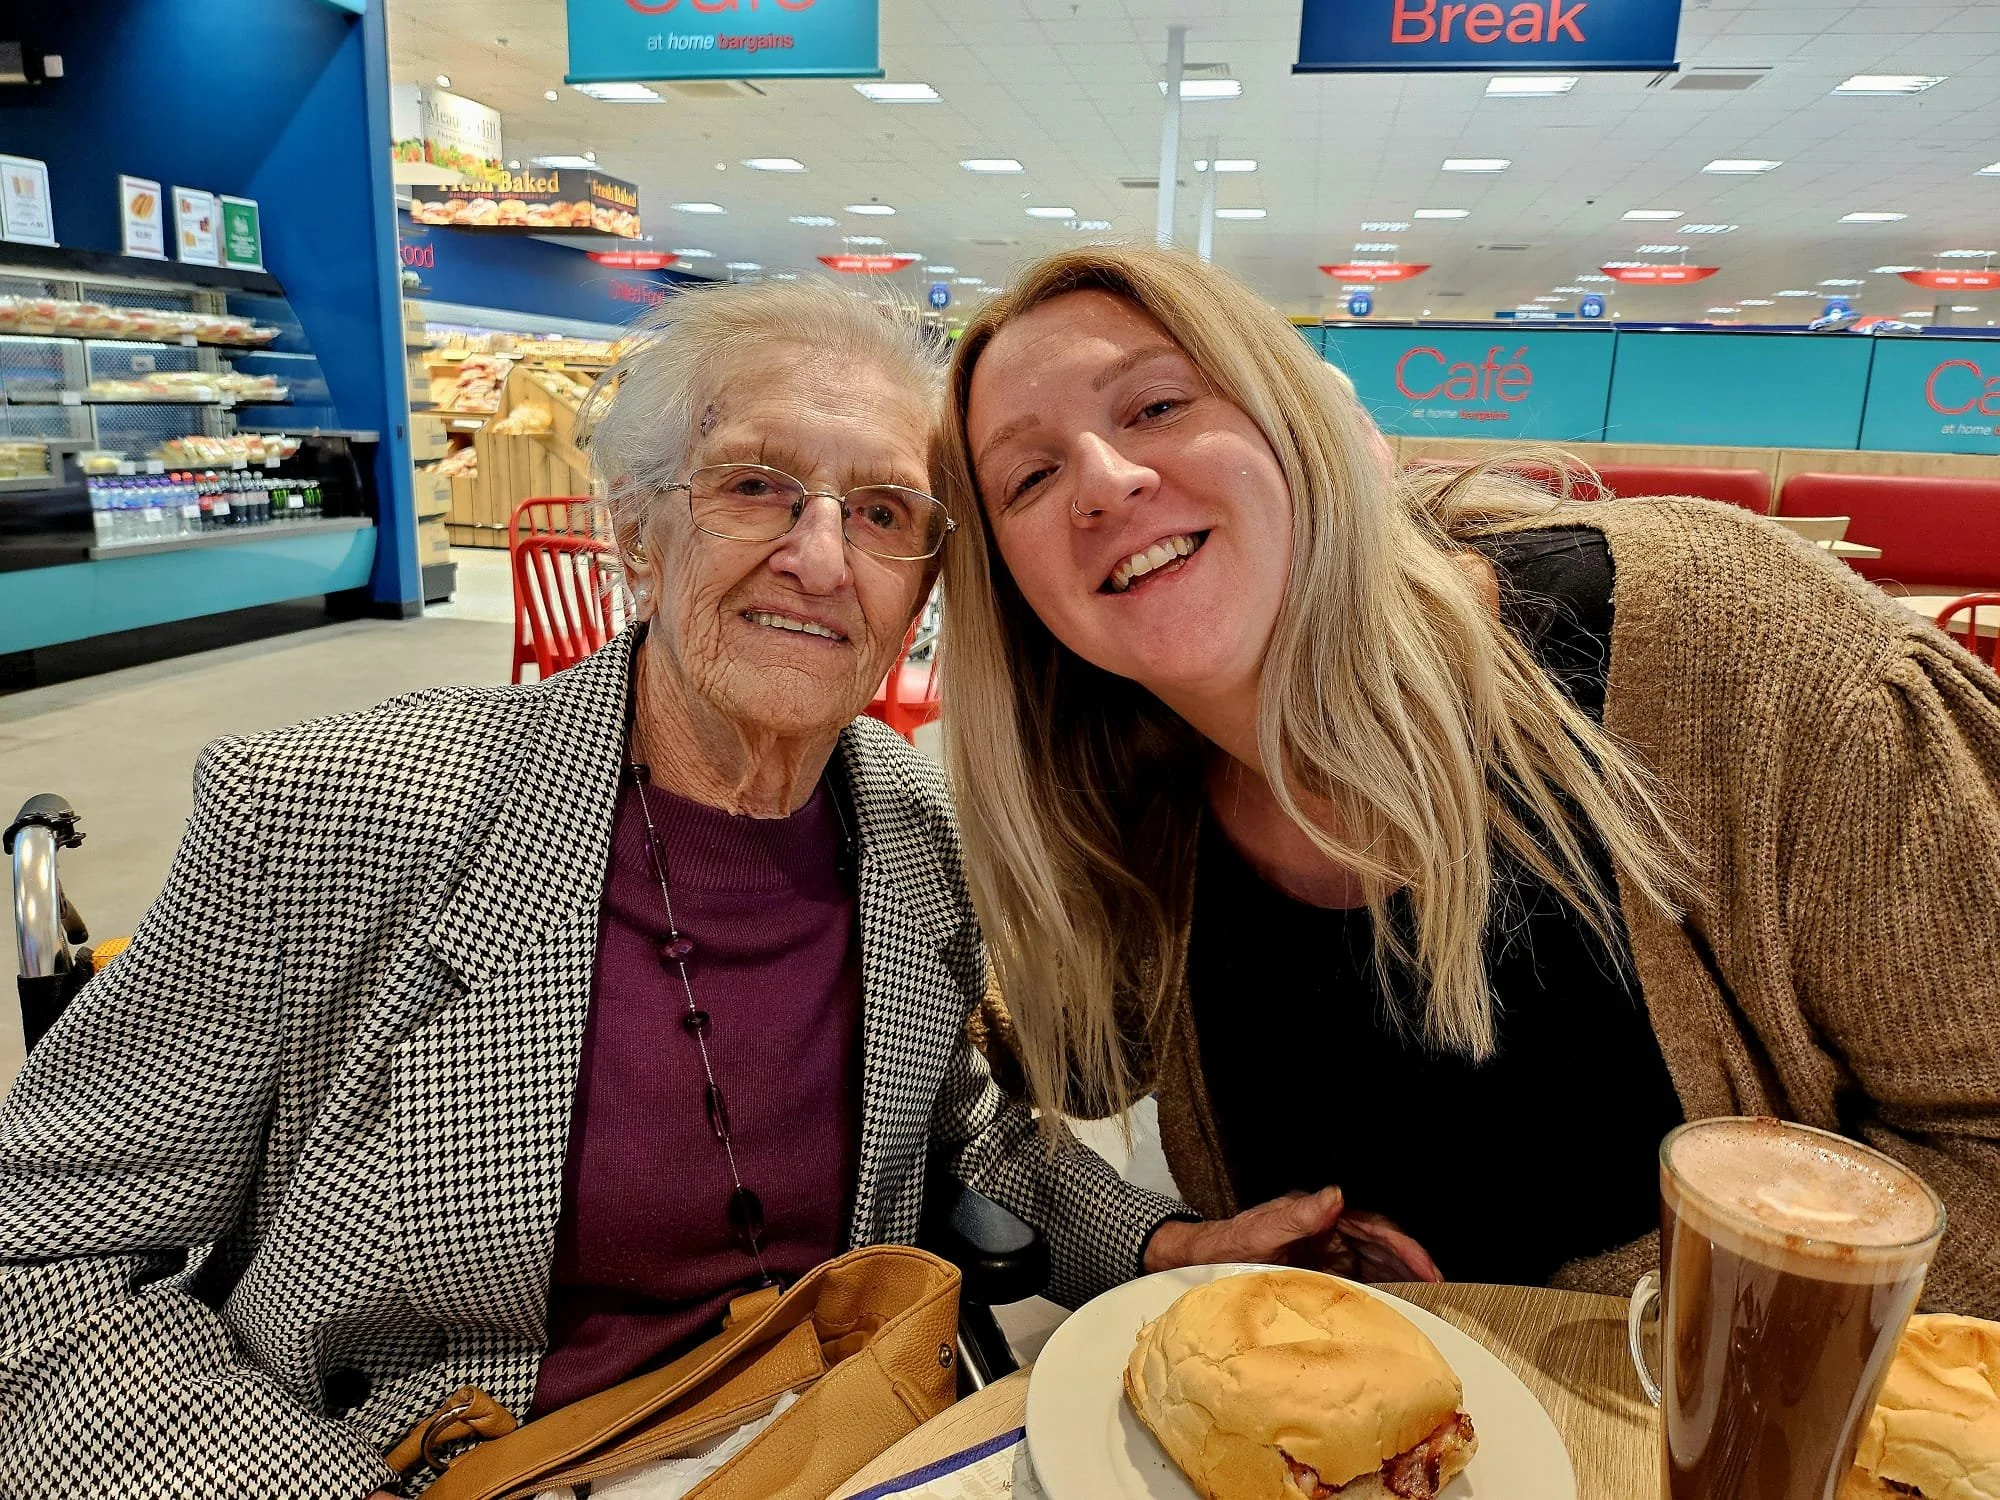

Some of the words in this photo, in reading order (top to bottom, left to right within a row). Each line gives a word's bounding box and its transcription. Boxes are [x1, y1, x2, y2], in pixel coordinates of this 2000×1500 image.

[1391, 0, 1588, 44] Break
[647, 33, 663, 50] at
[667, 32, 715, 50] home
[717, 33, 794, 53] bargains
[498, 170, 560, 193] Baked
[591, 178, 614, 201] Fresh
[614, 184, 637, 208] Baked
[1353, 301, 1368, 314] 11
[1583, 303, 1601, 317] 10
[1395, 346, 1533, 402] Café
[1459, 409, 1509, 421] bargains
[1941, 424, 1955, 434] at
[1956, 423, 1991, 436] home
